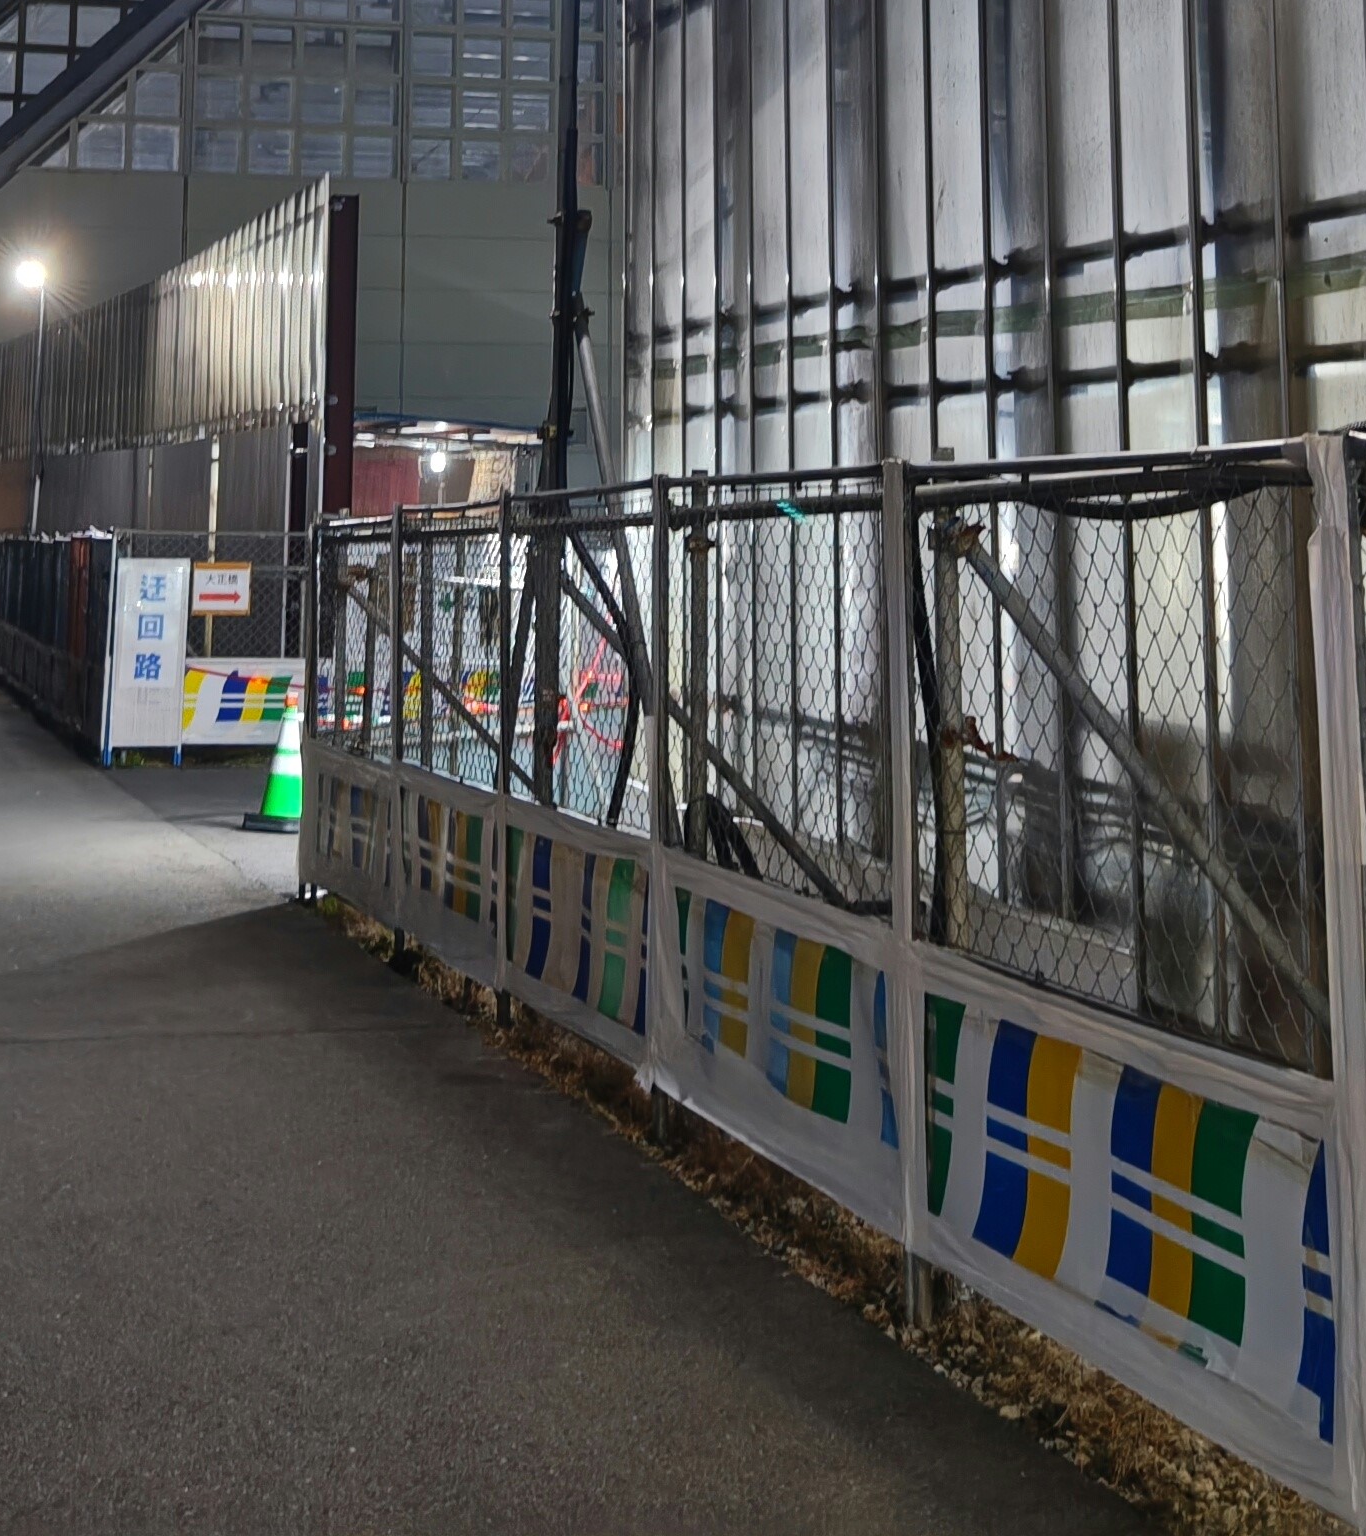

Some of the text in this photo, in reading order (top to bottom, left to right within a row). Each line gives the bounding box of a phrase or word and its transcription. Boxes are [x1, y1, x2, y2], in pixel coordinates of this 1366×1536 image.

[205, 573, 239, 586] 大正橋
[133, 574, 167, 681] 迂回路
